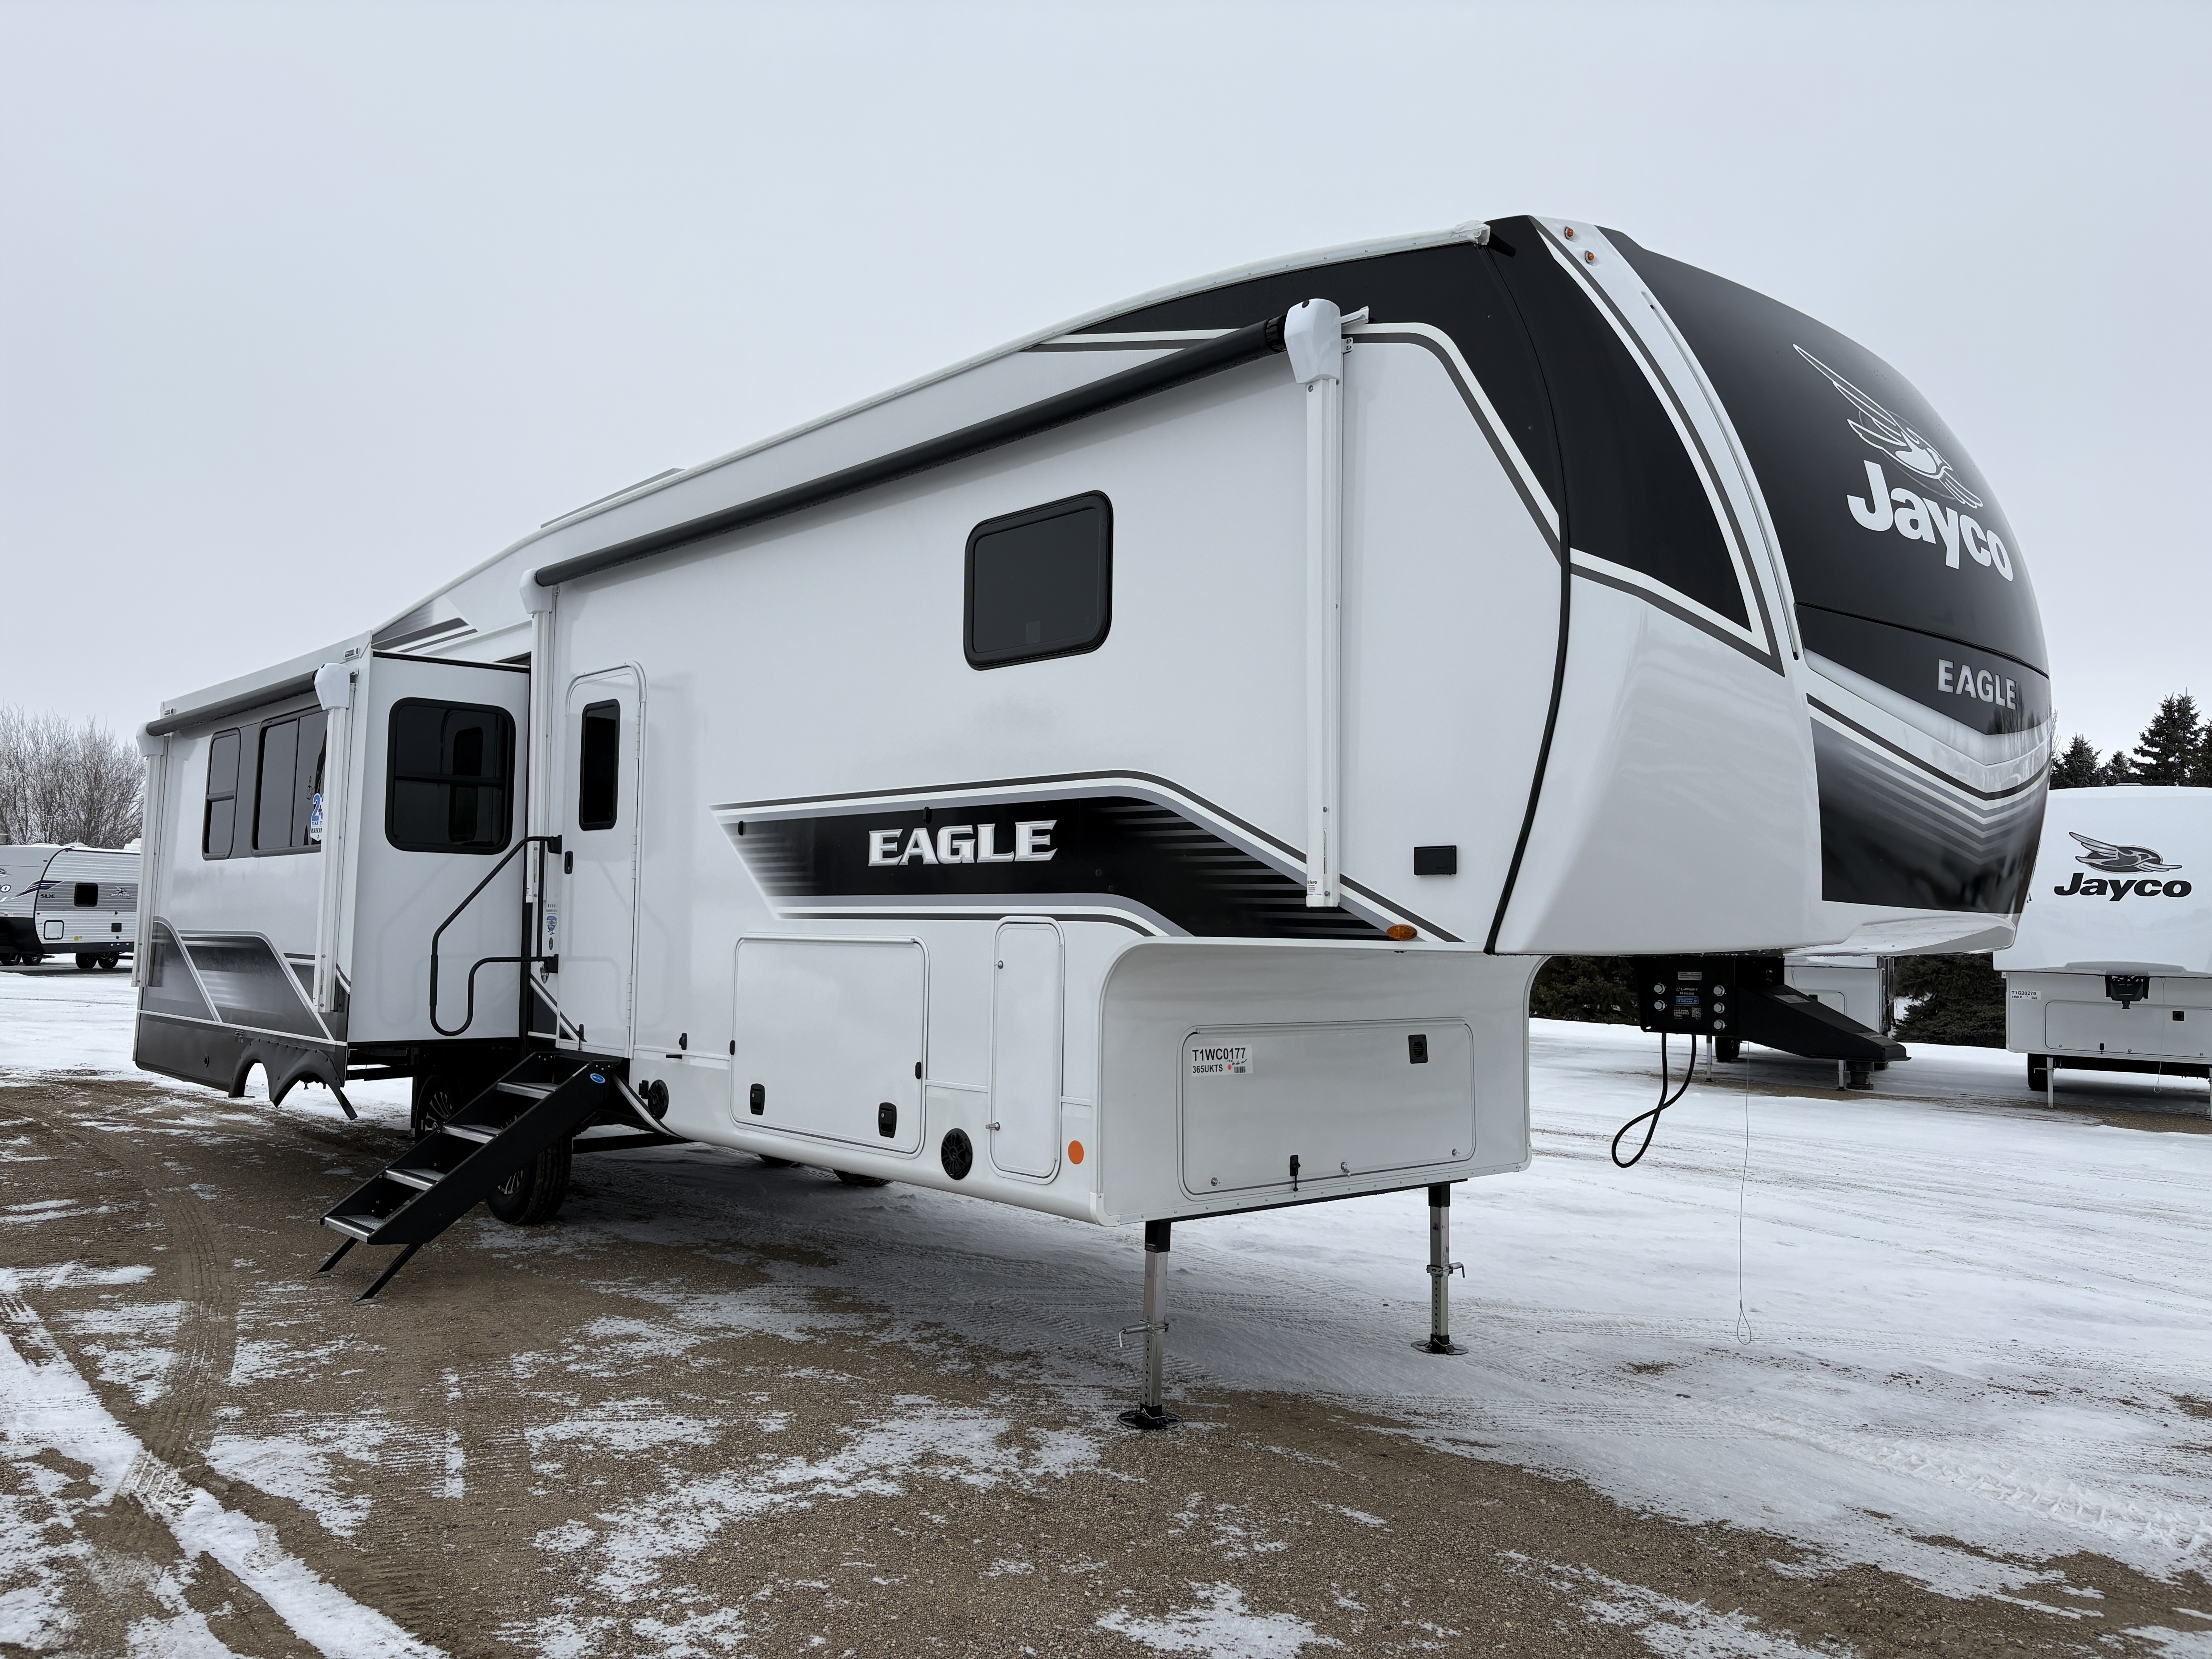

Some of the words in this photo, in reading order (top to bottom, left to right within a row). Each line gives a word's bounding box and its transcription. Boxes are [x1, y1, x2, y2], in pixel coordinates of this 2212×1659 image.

[1847, 460, 2013, 581] Jayco
[1938, 659, 2016, 710] EAGLE
[868, 820, 1058, 866] EAGLE
[2054, 872, 2192, 901] Jayco
[1192, 1047, 1246, 1061] T1WC0177
[1192, 1064, 1223, 1073] 365UKTS
